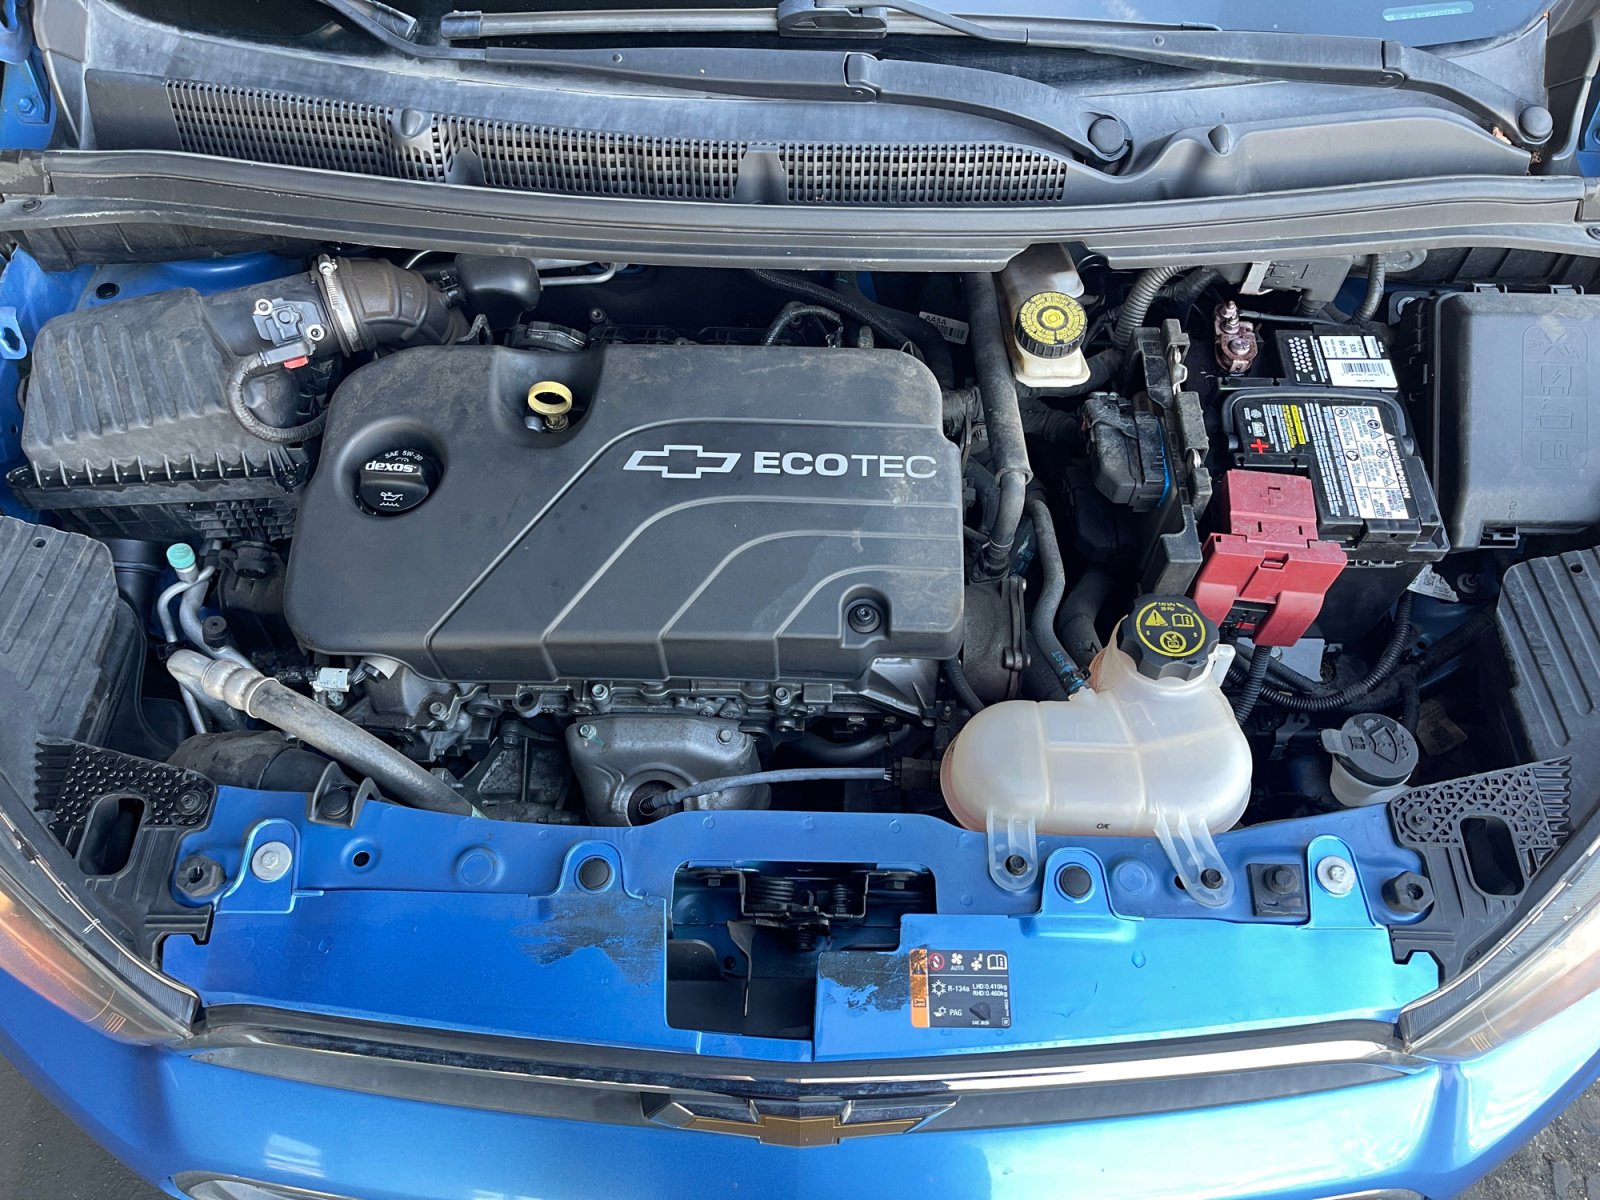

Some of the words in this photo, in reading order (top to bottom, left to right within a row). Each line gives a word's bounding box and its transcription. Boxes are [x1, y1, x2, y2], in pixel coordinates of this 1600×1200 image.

[385, 450, 399, 459] SAE
[402, 450, 423, 461] 5W-20
[753, 451, 937, 479] ECOTEC
[365, 460, 415, 473] dexos
[1387, 440, 1411, 498] DANGER/POISON
